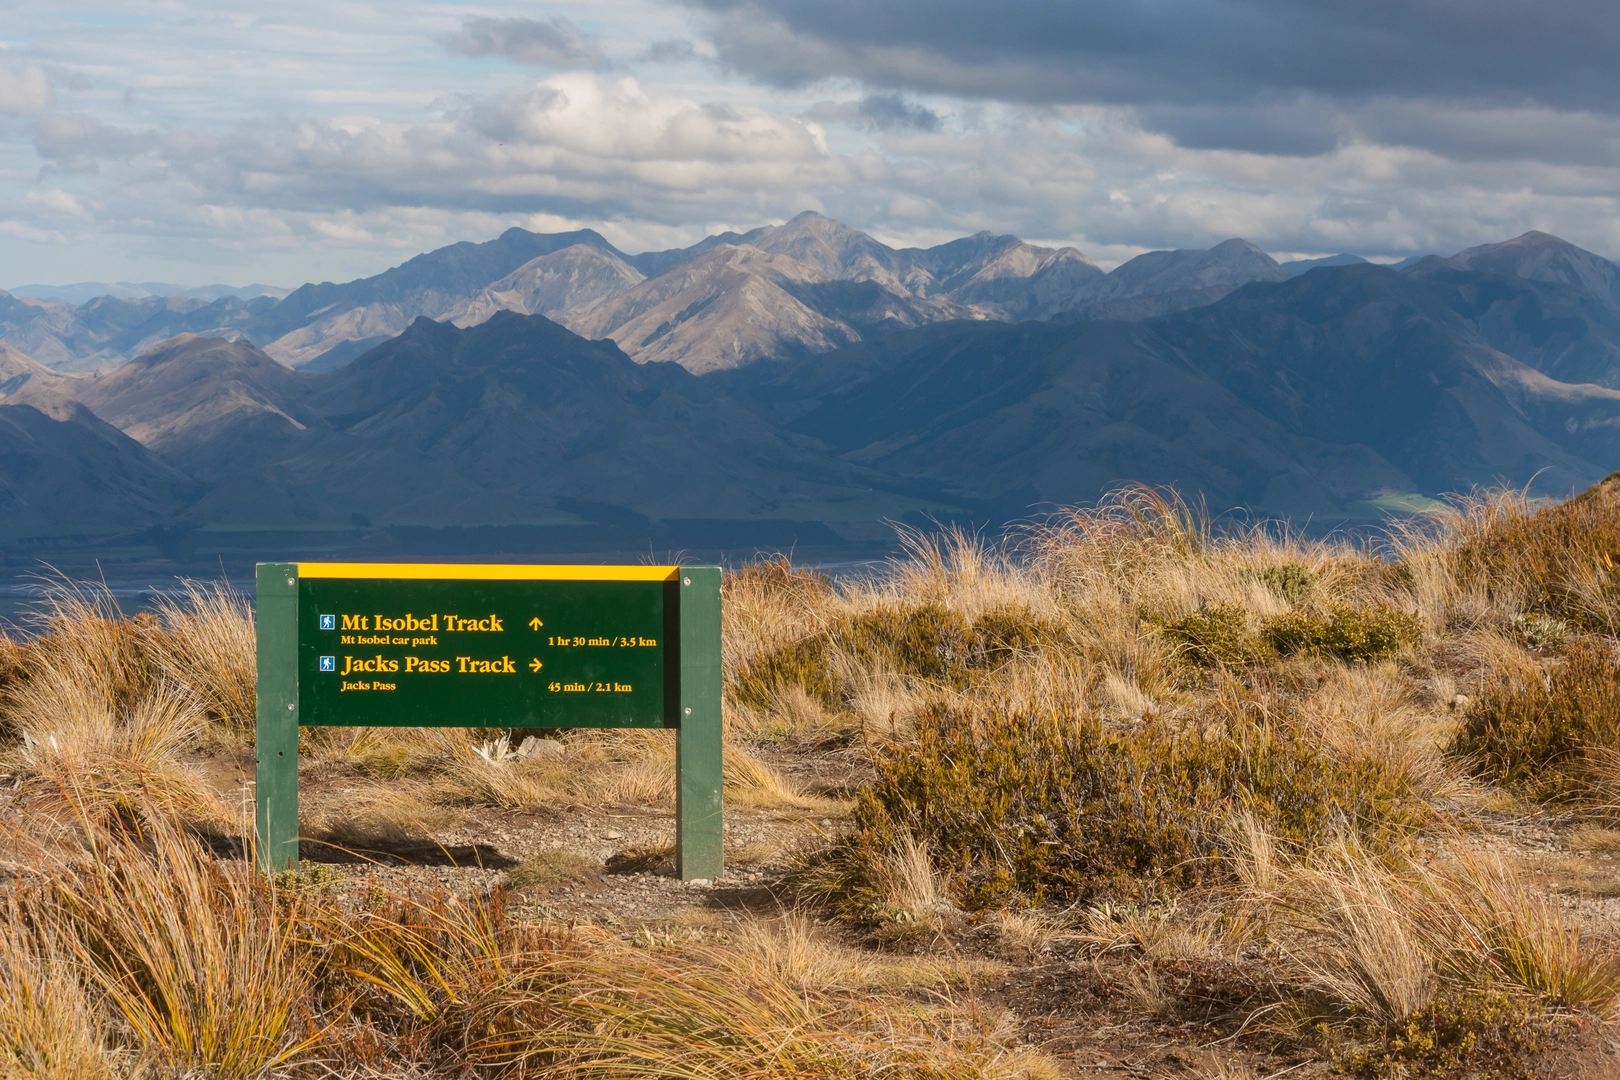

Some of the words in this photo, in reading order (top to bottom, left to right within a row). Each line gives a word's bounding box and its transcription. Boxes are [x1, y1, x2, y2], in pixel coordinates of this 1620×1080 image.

[341, 614, 369, 631] Mt
[374, 614, 439, 631] Isobel
[443, 614, 503, 631] Track
[341, 635, 355, 645] Mt
[358, 635, 390, 645] Isobel
[392, 637, 410, 645] car
[412, 635, 438, 648] park
[548, 636, 555, 646] 1
[557, 636, 571, 646] hr
[573, 637, 586, 647] 30
[588, 636, 610, 646] min
[612, 636, 619, 647] /
[620, 636, 637, 647] 3.5
[639, 636, 657, 647] km
[341, 655, 399, 676] Jacks
[405, 657, 450, 673] Pass
[456, 656, 517, 673] Track
[341, 681, 370, 692] Jacks
[373, 681, 397, 691] Pass
[547, 682, 561, 692] 45
[564, 682, 586, 692] min
[587, 682, 594, 692] /
[595, 682, 612, 692] 2.1
[614, 682, 633, 692] km
